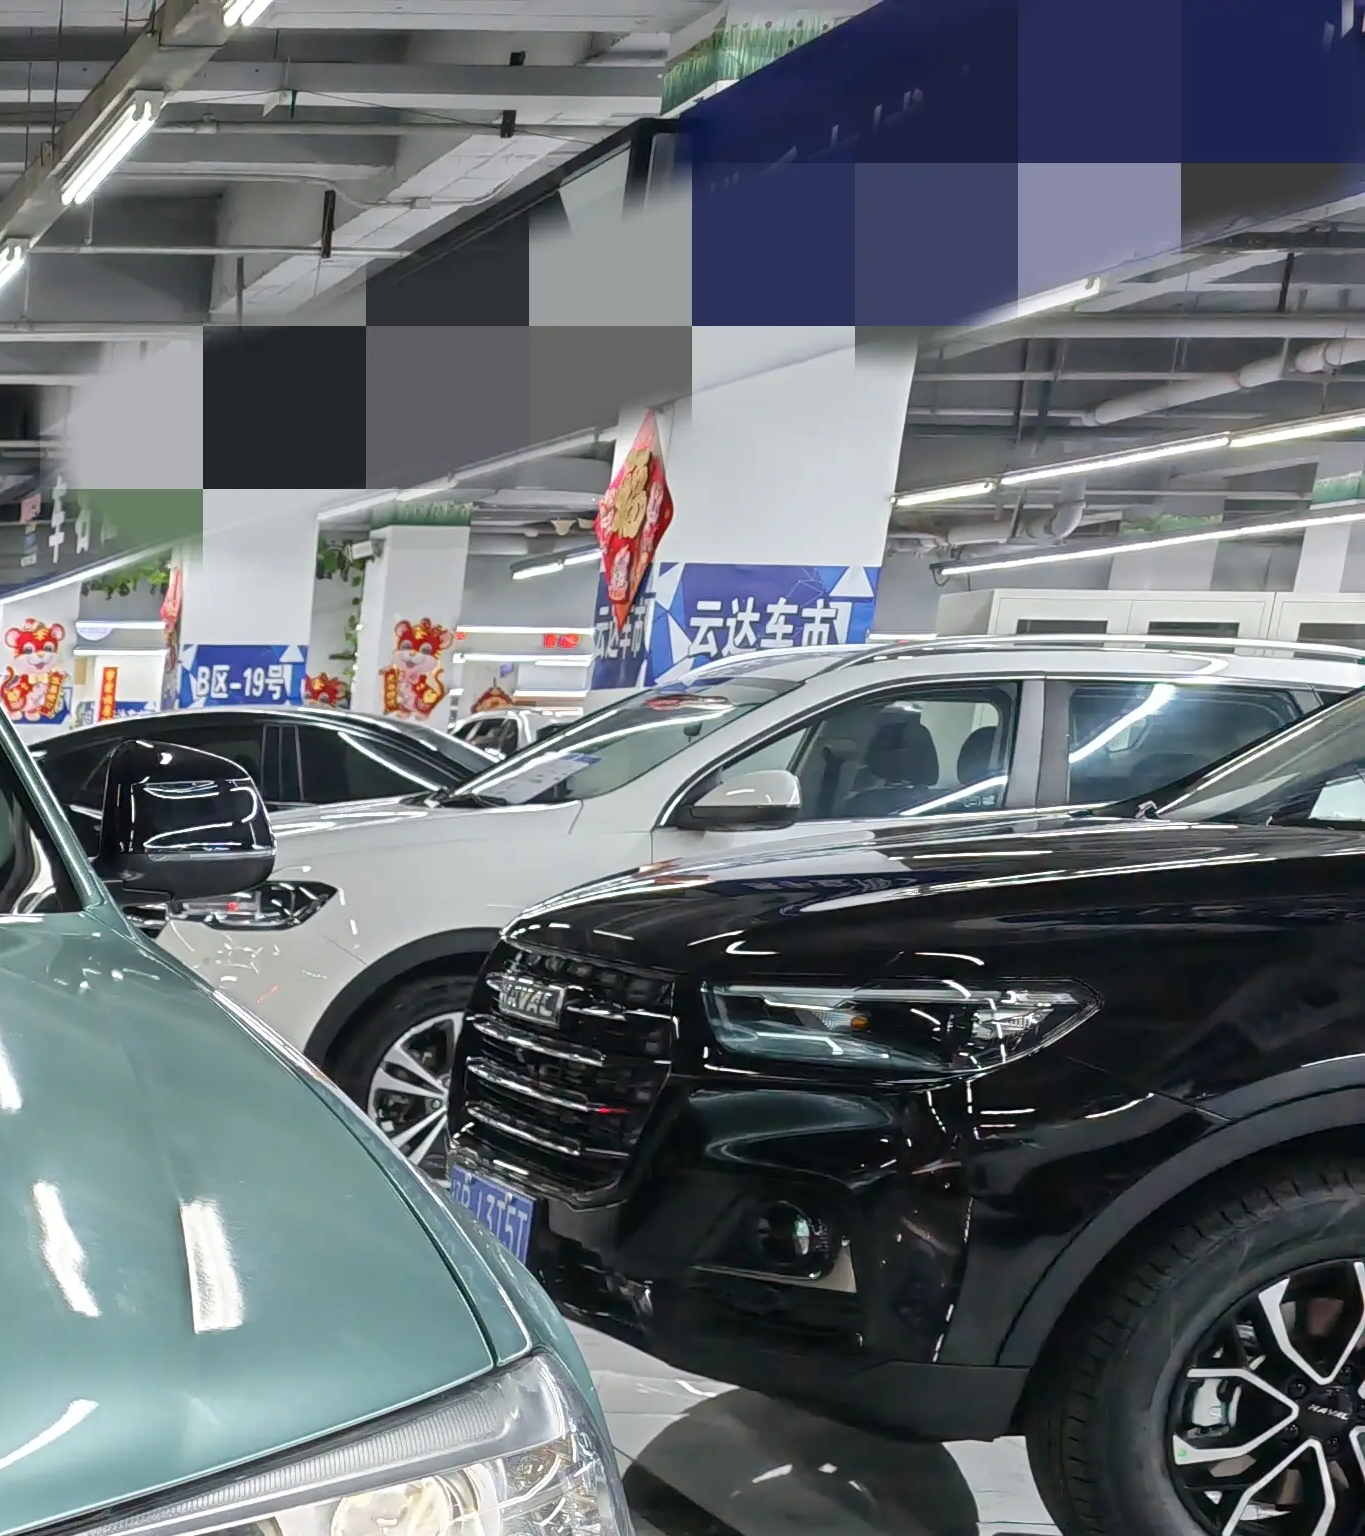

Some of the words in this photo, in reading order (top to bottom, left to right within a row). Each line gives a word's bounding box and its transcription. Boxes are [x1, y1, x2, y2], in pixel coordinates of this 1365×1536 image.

[689, 596, 838, 657] 云达车市
[195, 664, 284, 700] B区-19号
